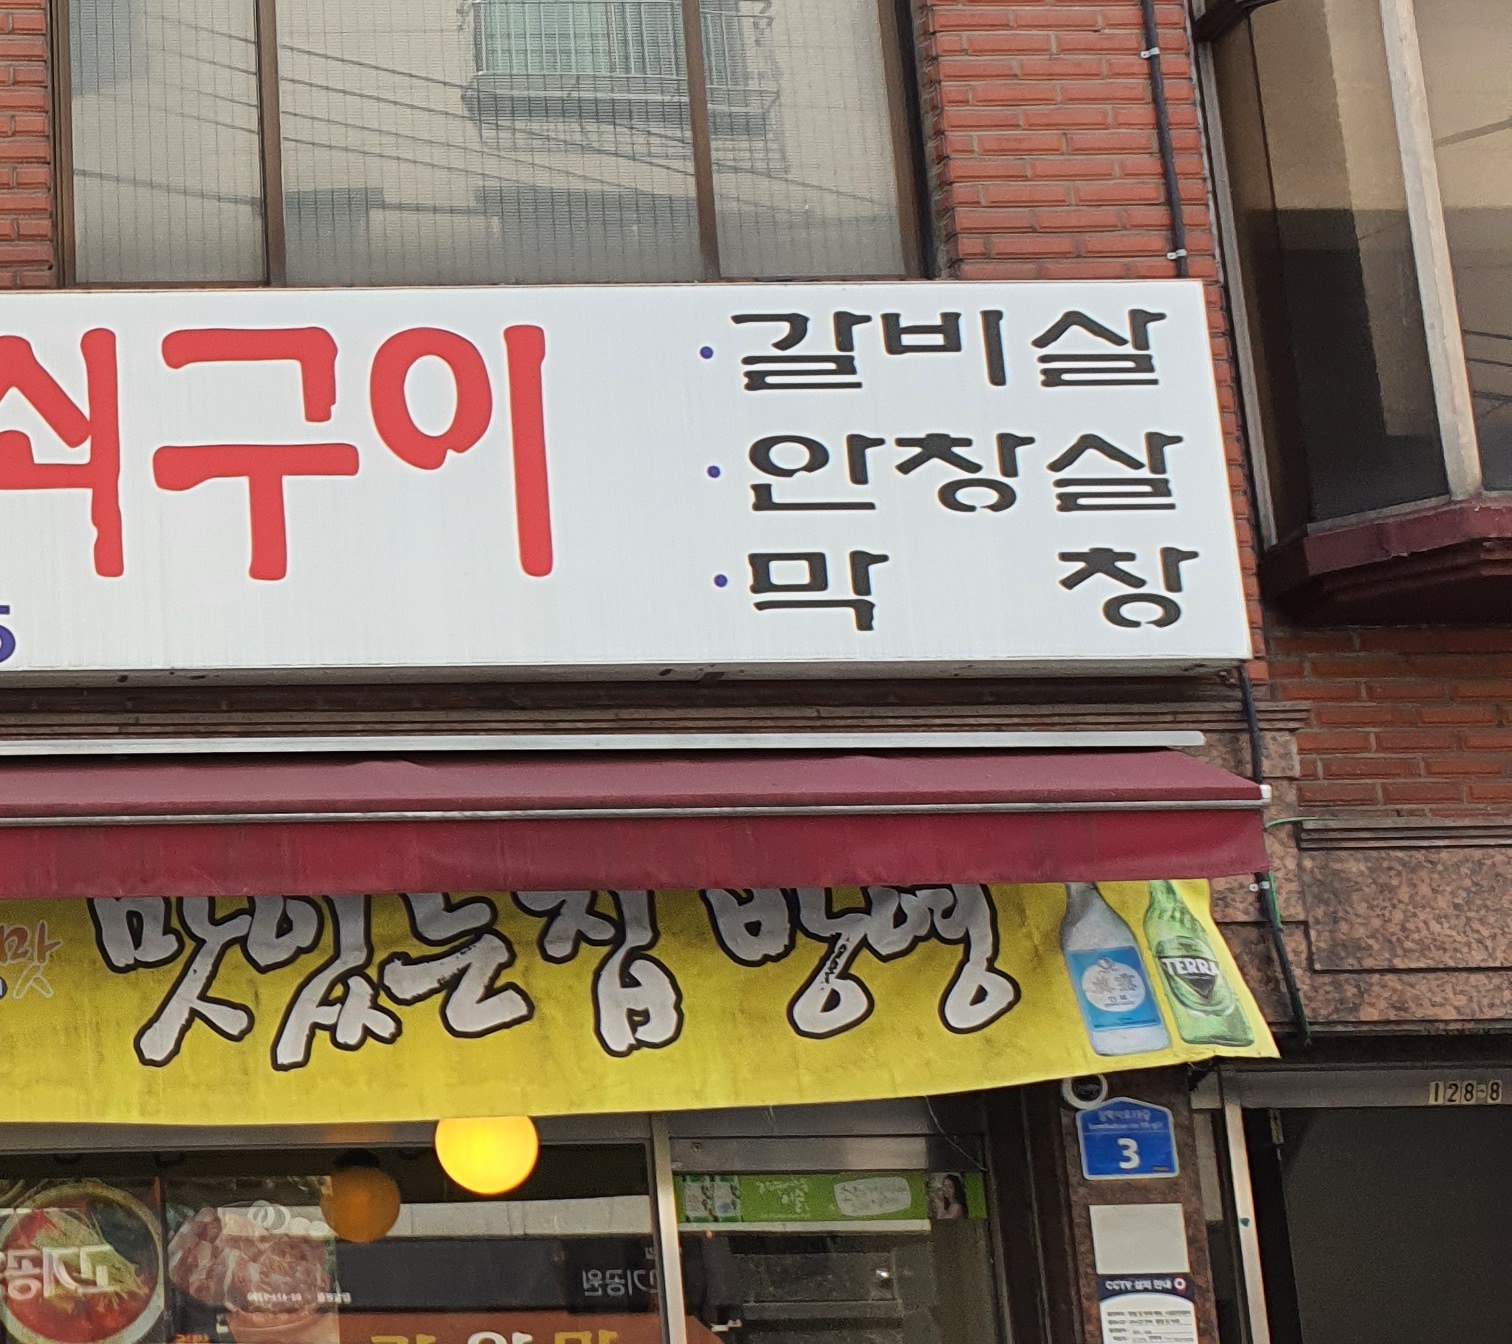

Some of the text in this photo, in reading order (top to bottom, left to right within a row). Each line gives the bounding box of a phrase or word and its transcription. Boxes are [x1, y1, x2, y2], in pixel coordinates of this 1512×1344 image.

[730, 308, 1167, 391] 갈비살
[748, 431, 1184, 513] 안창살
[1162, 956, 1221, 978] TERRA
[1433, 1081, 1501, 1103] 128-8
[1117, 1137, 1140, 1169] 3
